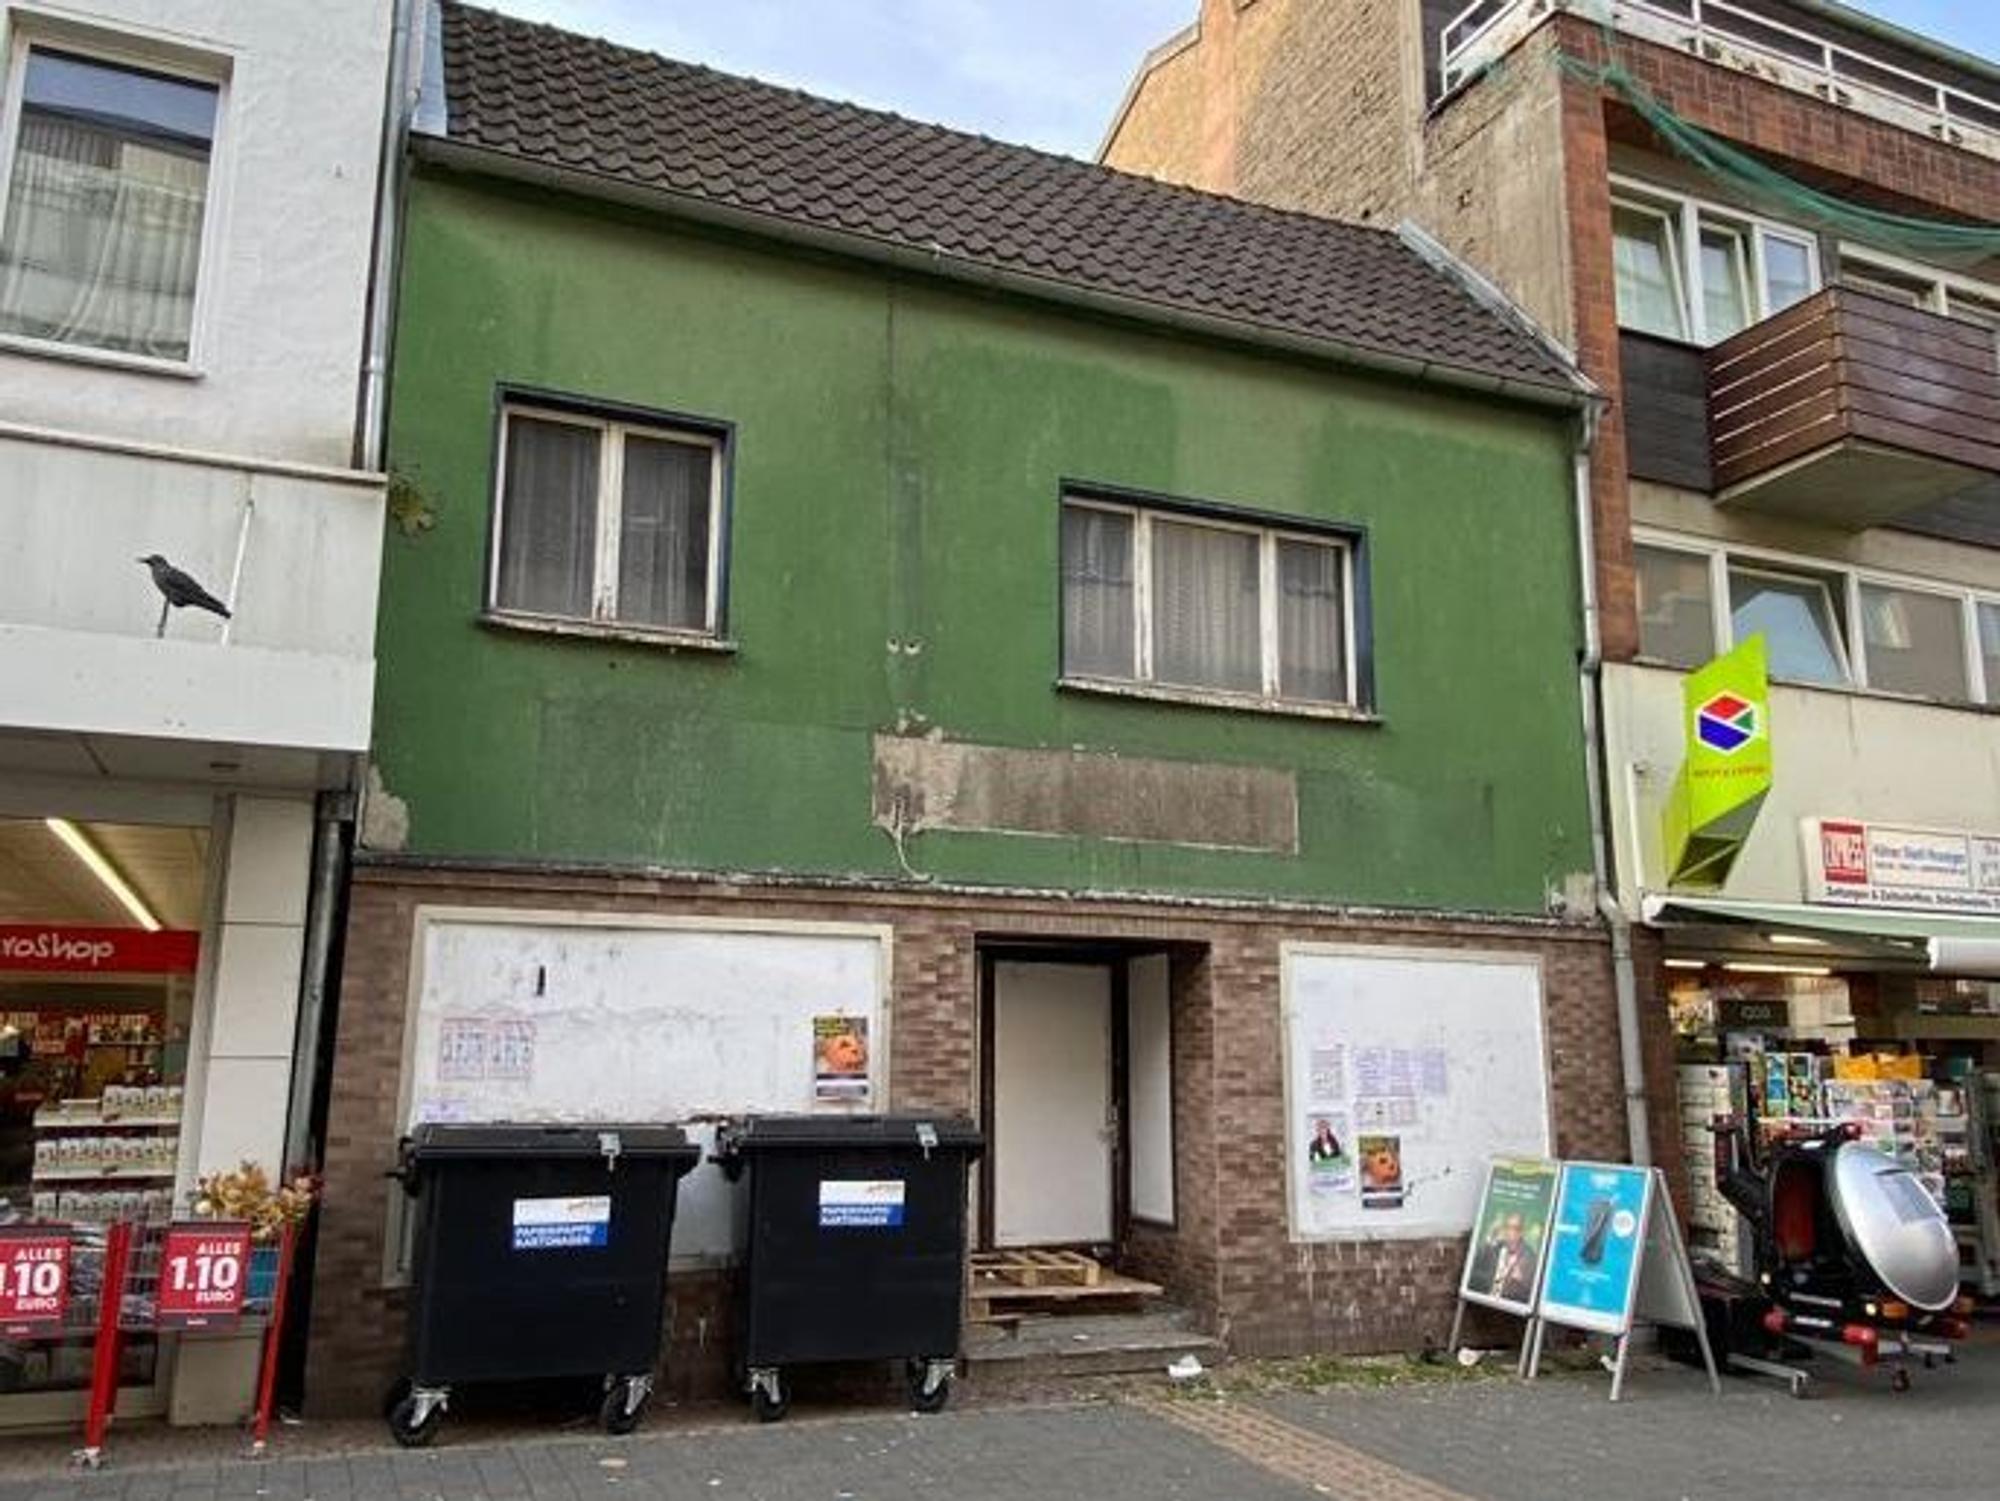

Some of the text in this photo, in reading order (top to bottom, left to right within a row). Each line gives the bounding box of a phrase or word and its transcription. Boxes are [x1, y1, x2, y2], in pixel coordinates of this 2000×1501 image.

[15, 1248, 63, 1261] ALLES
[196, 1242, 241, 1255] ALLES
[170, 1256, 239, 1290] 1.10
[195, 1290, 235, 1303] EURO
[15, 1297, 57, 1311] EURO
